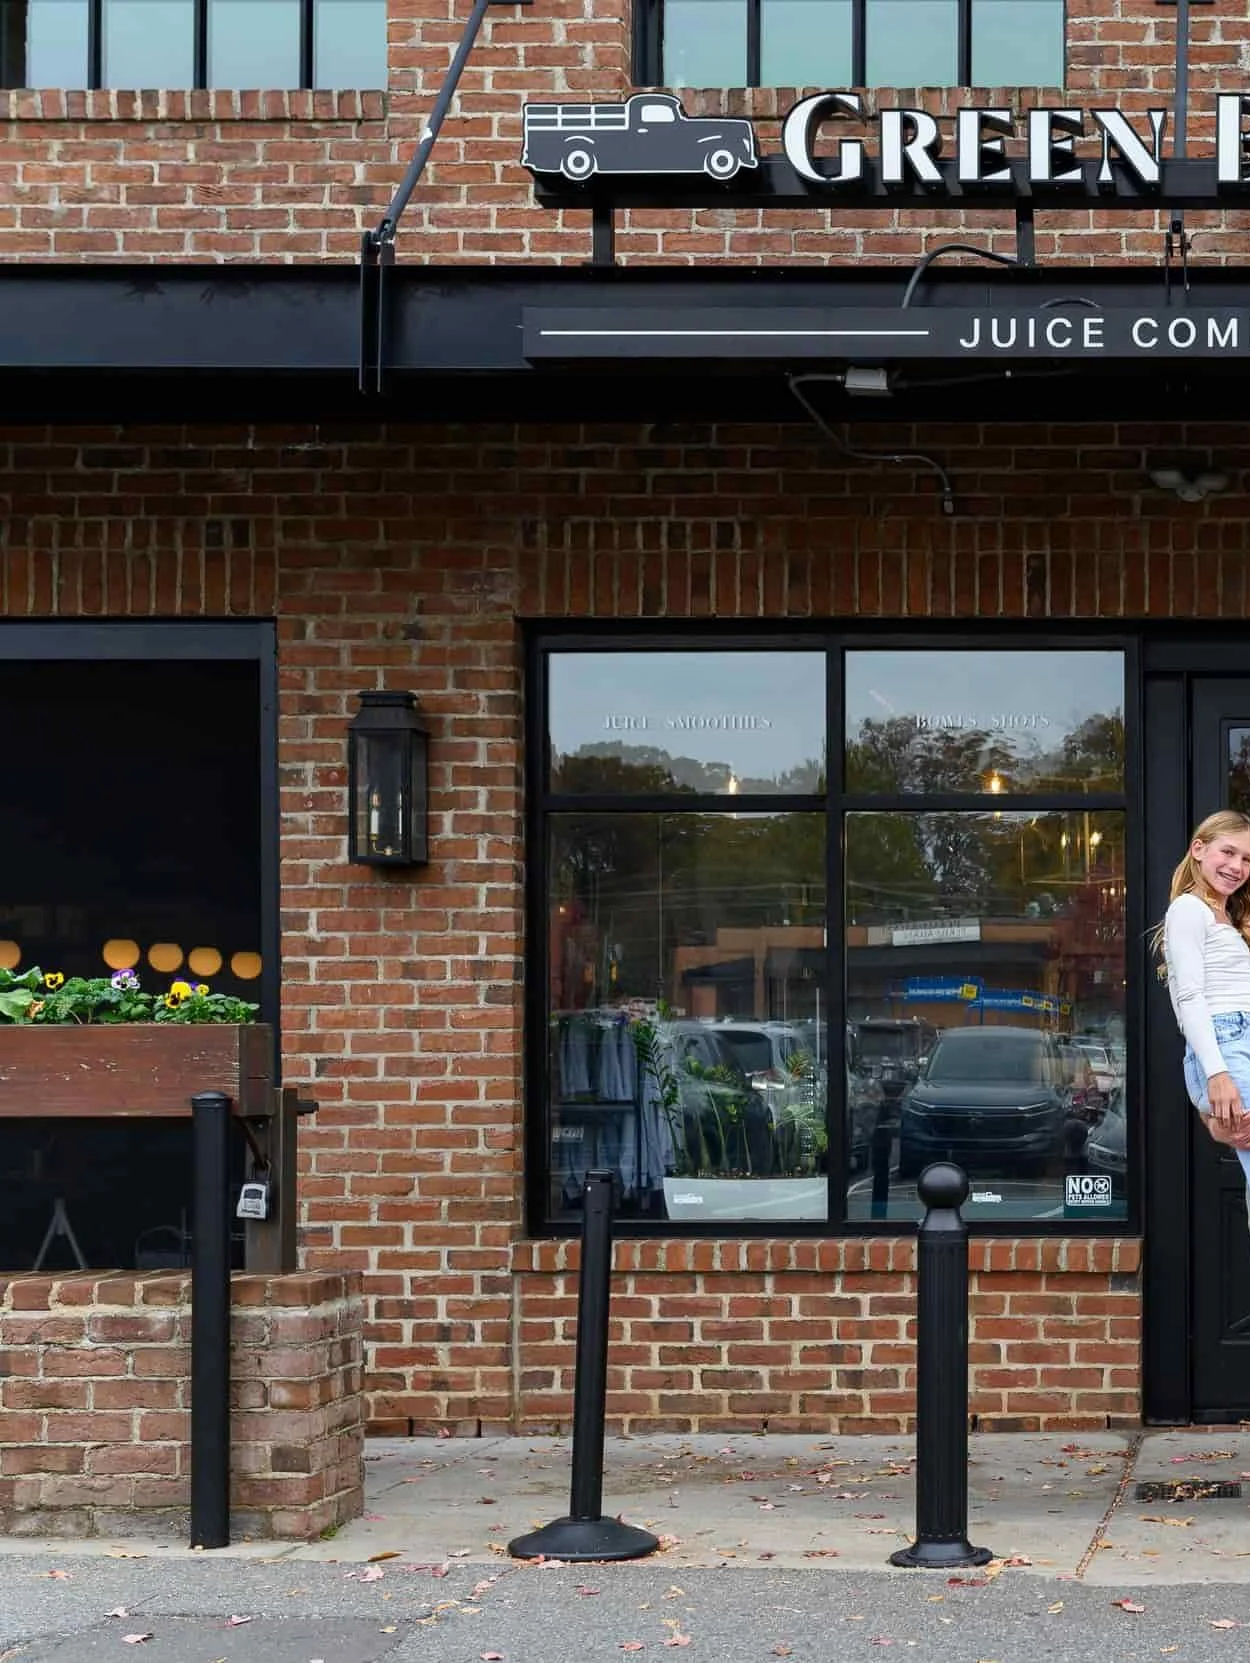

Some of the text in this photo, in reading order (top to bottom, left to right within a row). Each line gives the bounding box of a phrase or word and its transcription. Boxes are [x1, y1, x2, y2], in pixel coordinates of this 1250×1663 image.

[782, 91, 1166, 185] GREEN
[959, 317, 1105, 348] JUICE
[1069, 1178, 1093, 1194] NO
